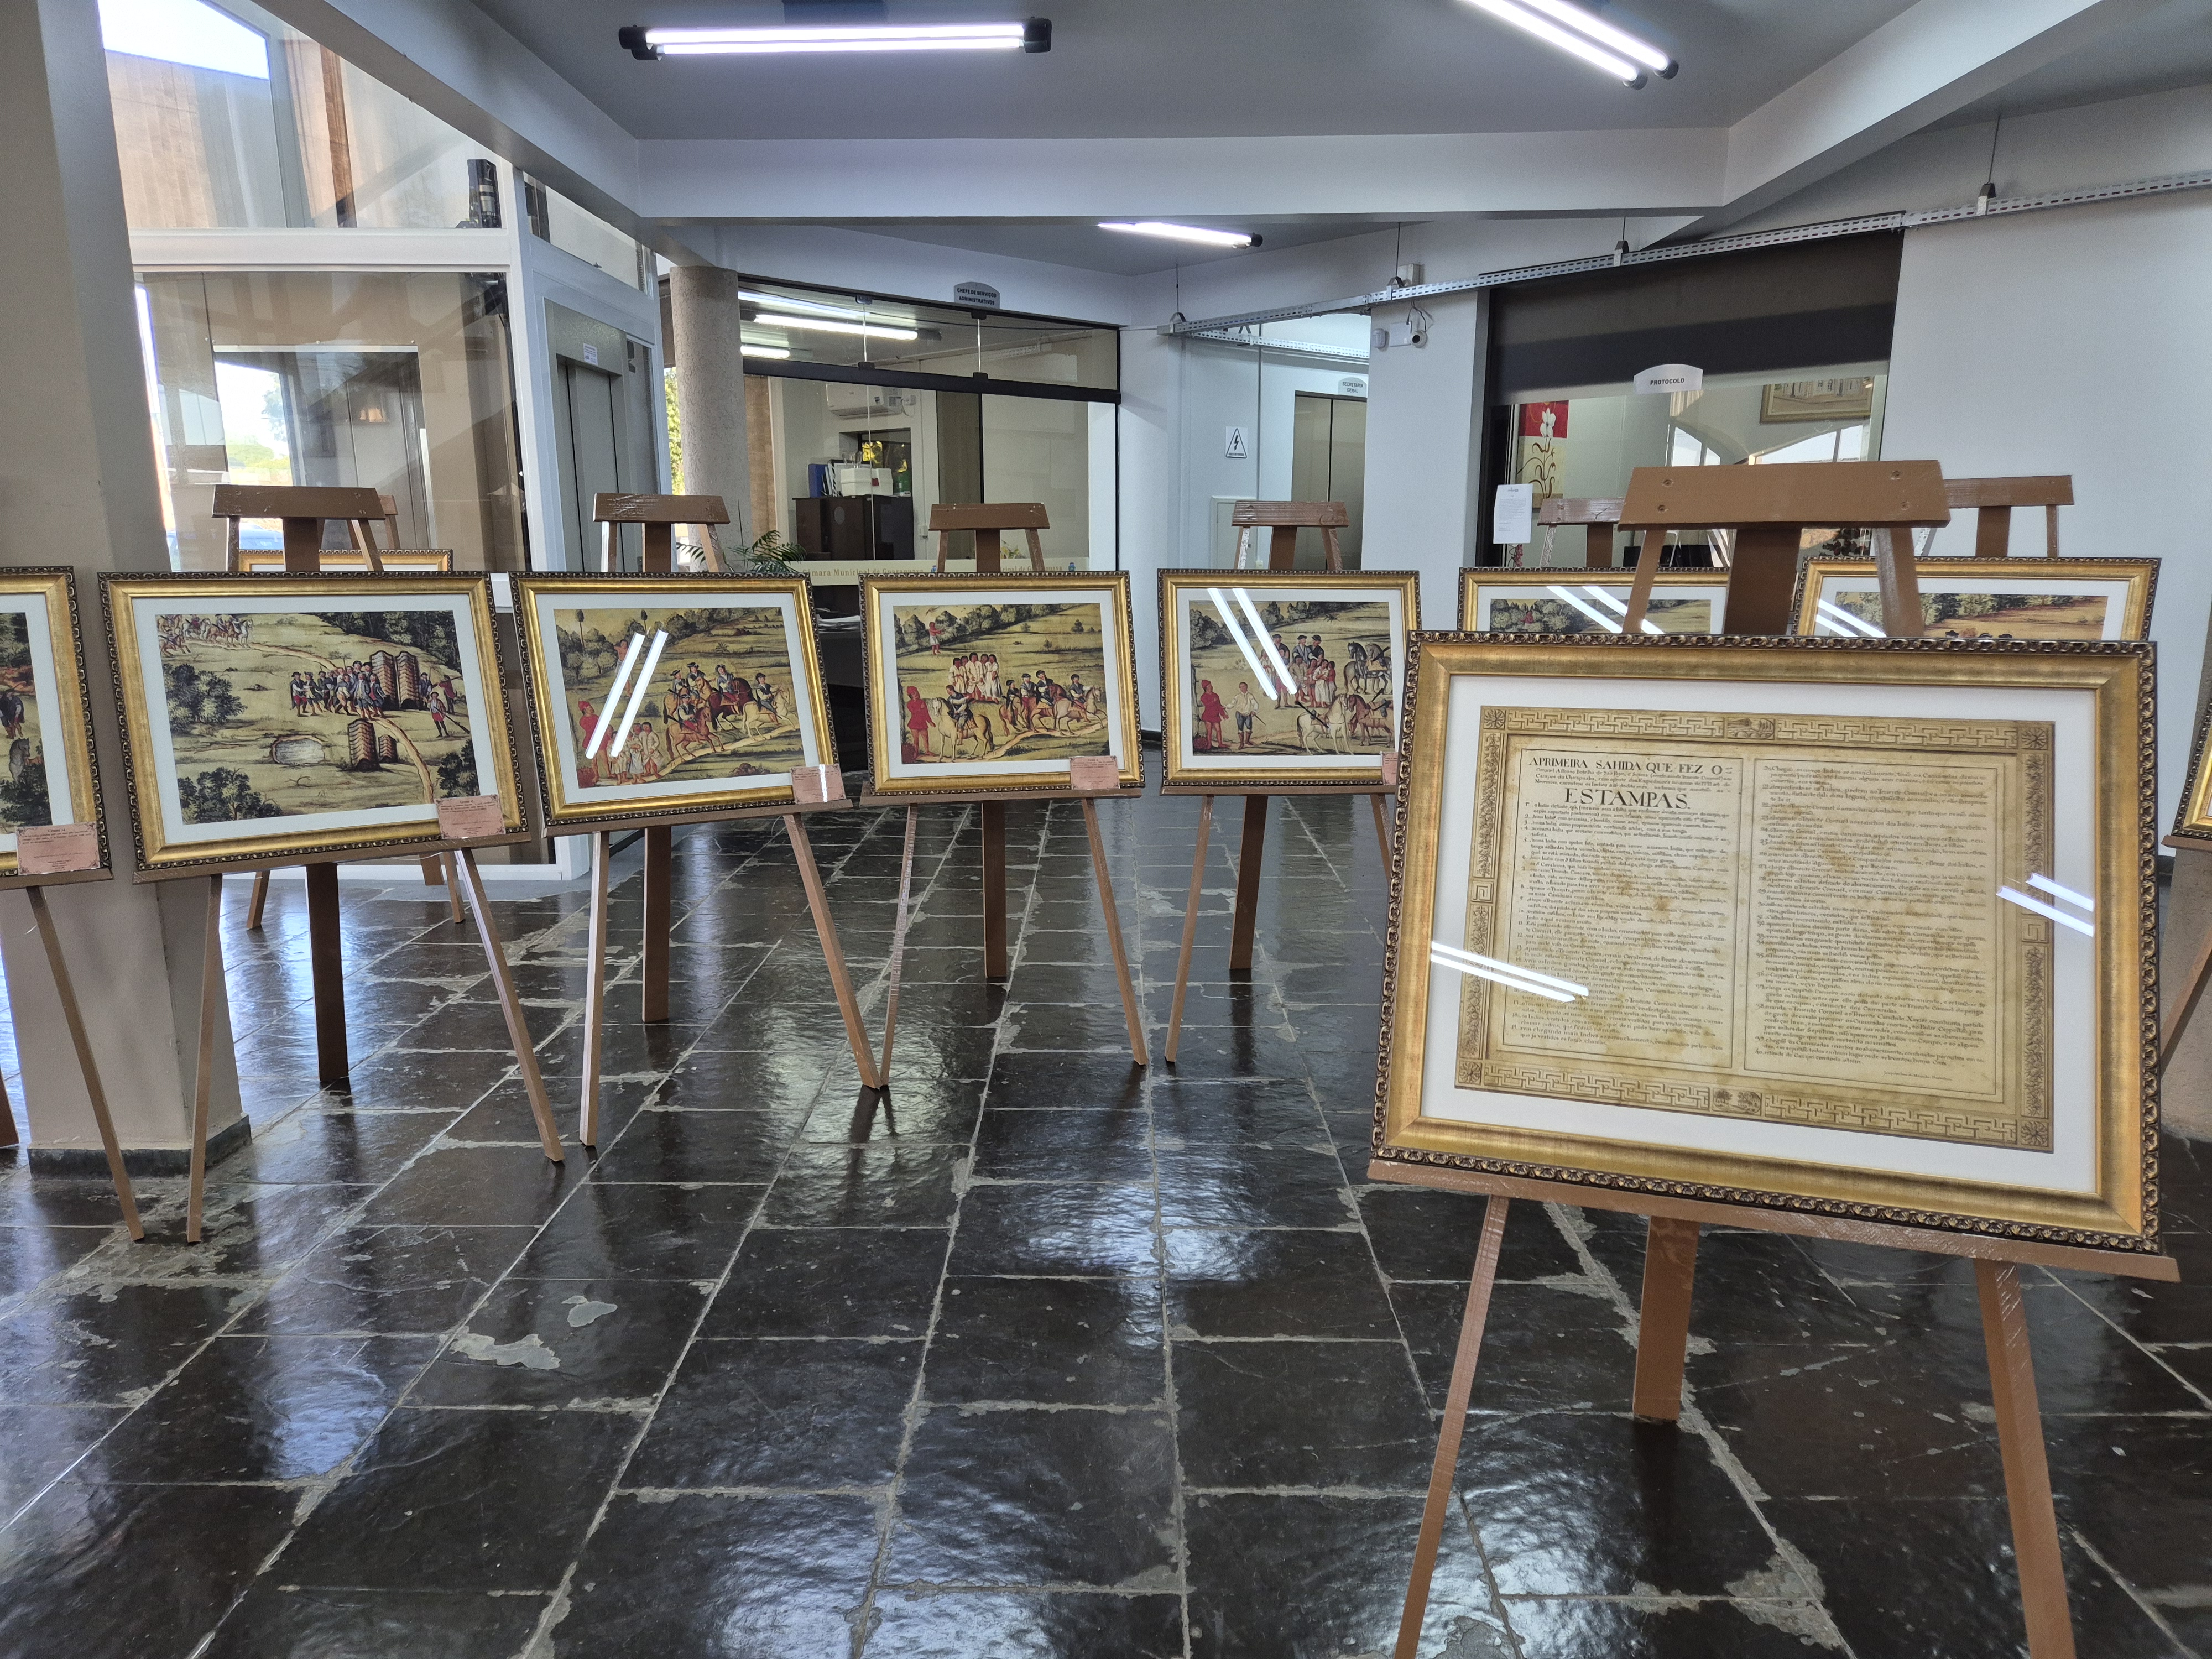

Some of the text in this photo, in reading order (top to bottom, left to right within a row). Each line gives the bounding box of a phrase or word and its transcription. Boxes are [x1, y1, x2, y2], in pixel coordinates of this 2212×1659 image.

[959, 296, 995, 305] ADMINISTRATIVOS
[1595, 759, 1641, 770] SAHIDA
[1646, 761, 1672, 774] QUE
[1678, 764, 1703, 774] FEZ
[1711, 765, 1723, 775] O
